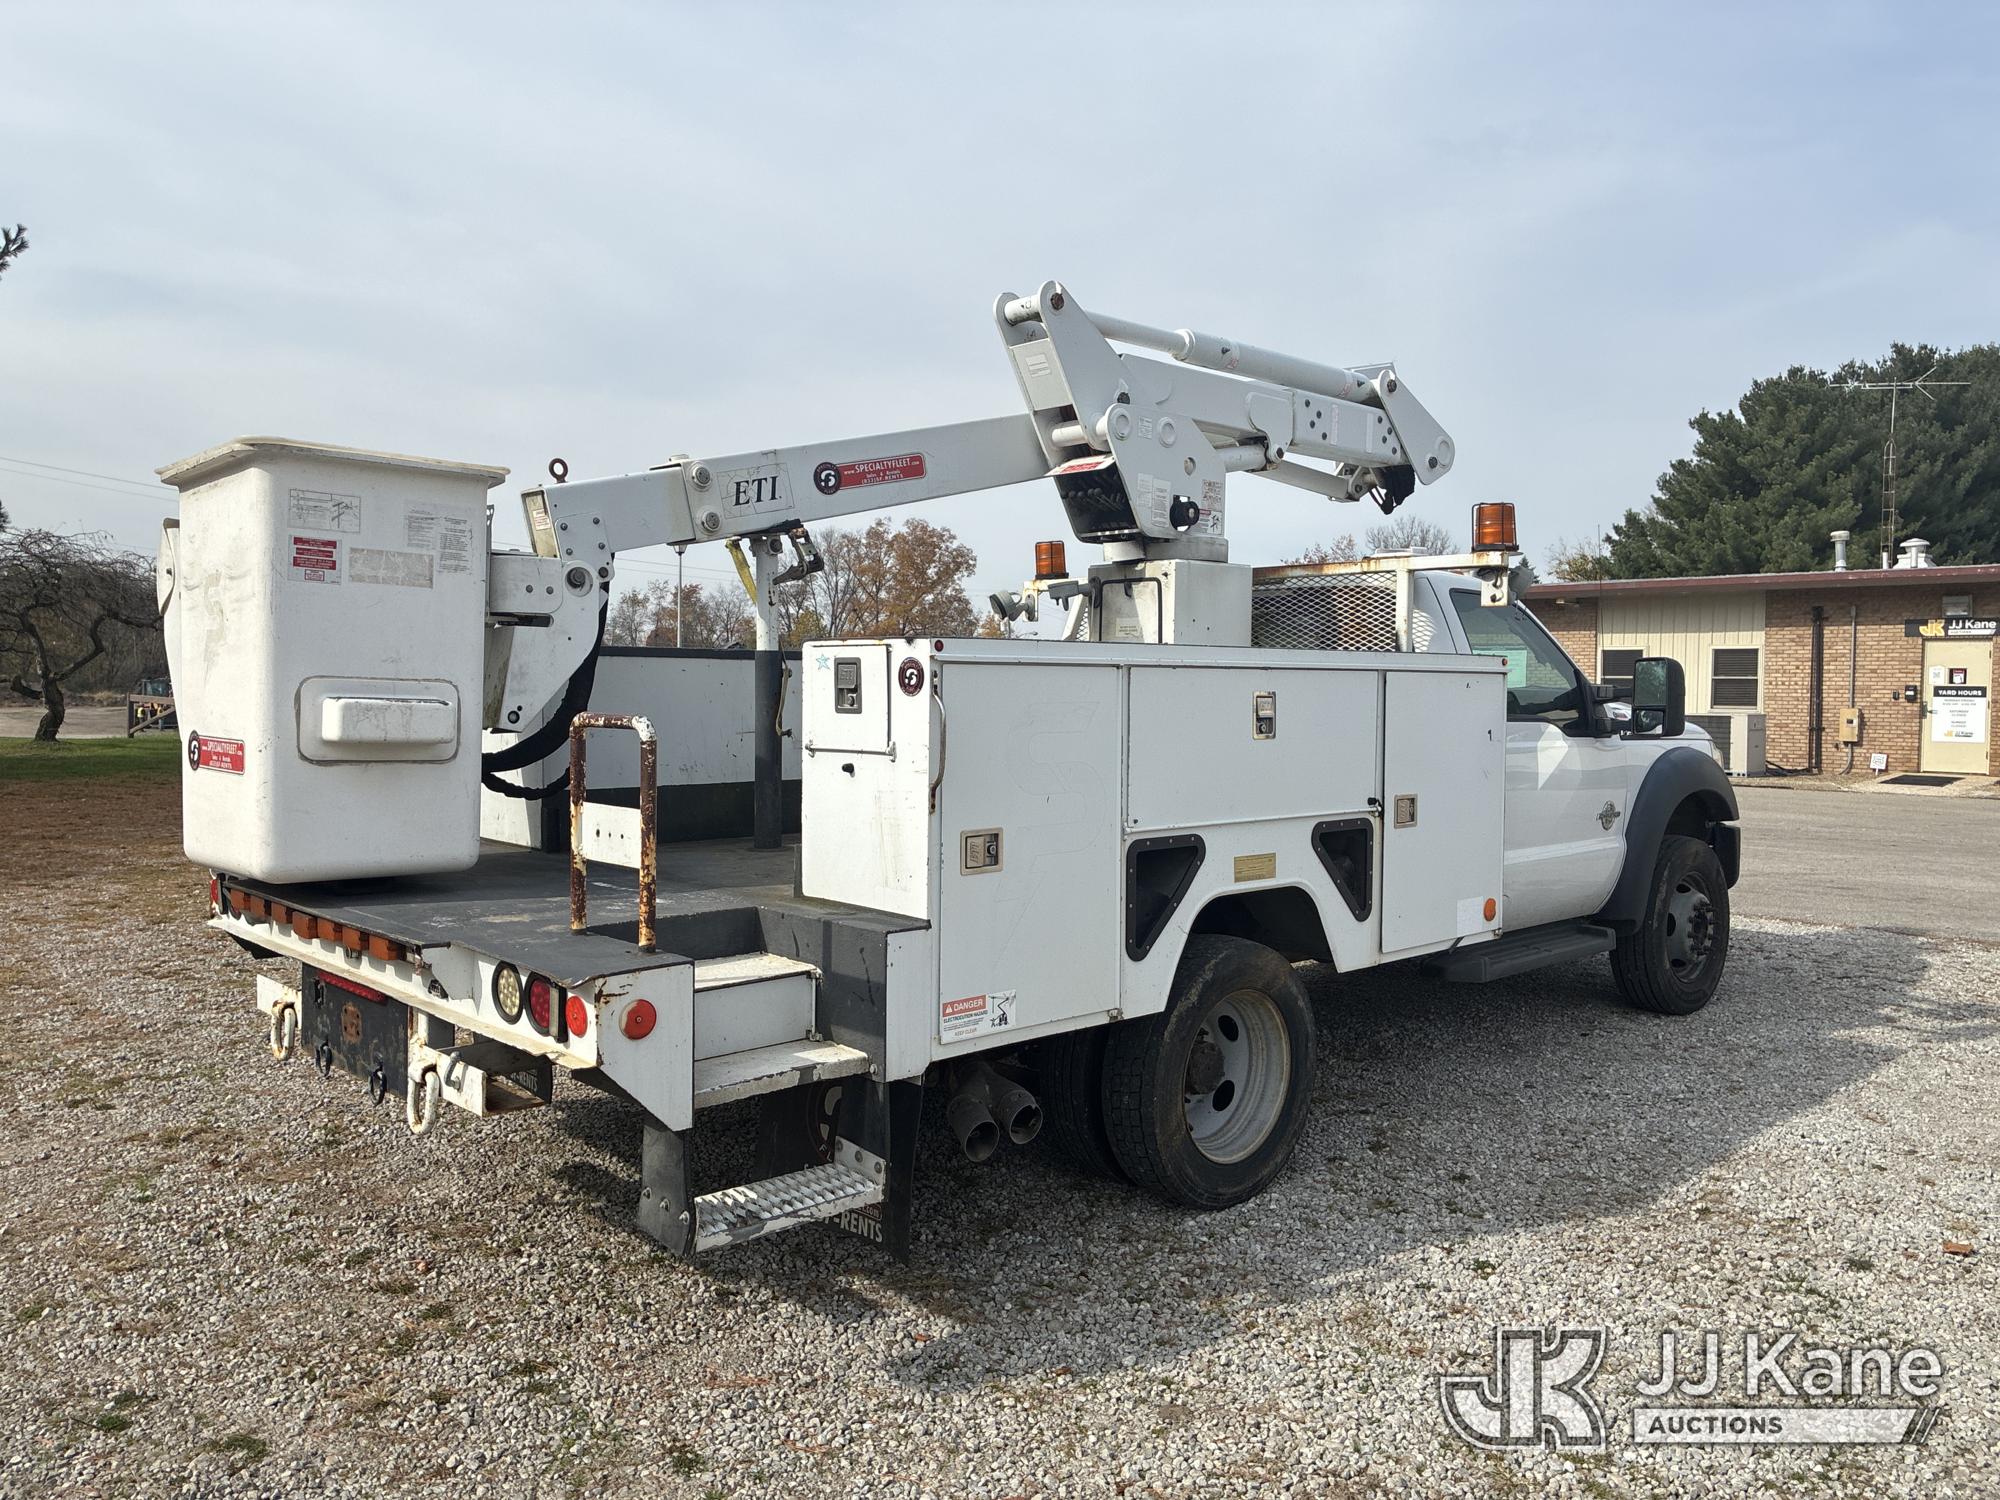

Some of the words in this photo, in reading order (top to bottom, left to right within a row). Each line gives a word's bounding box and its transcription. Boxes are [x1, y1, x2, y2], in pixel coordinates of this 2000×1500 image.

[1949, 620, 1962, 629] JJ
[1965, 620, 1997, 629] Kane
[953, 999, 983, 1011] DANGER
